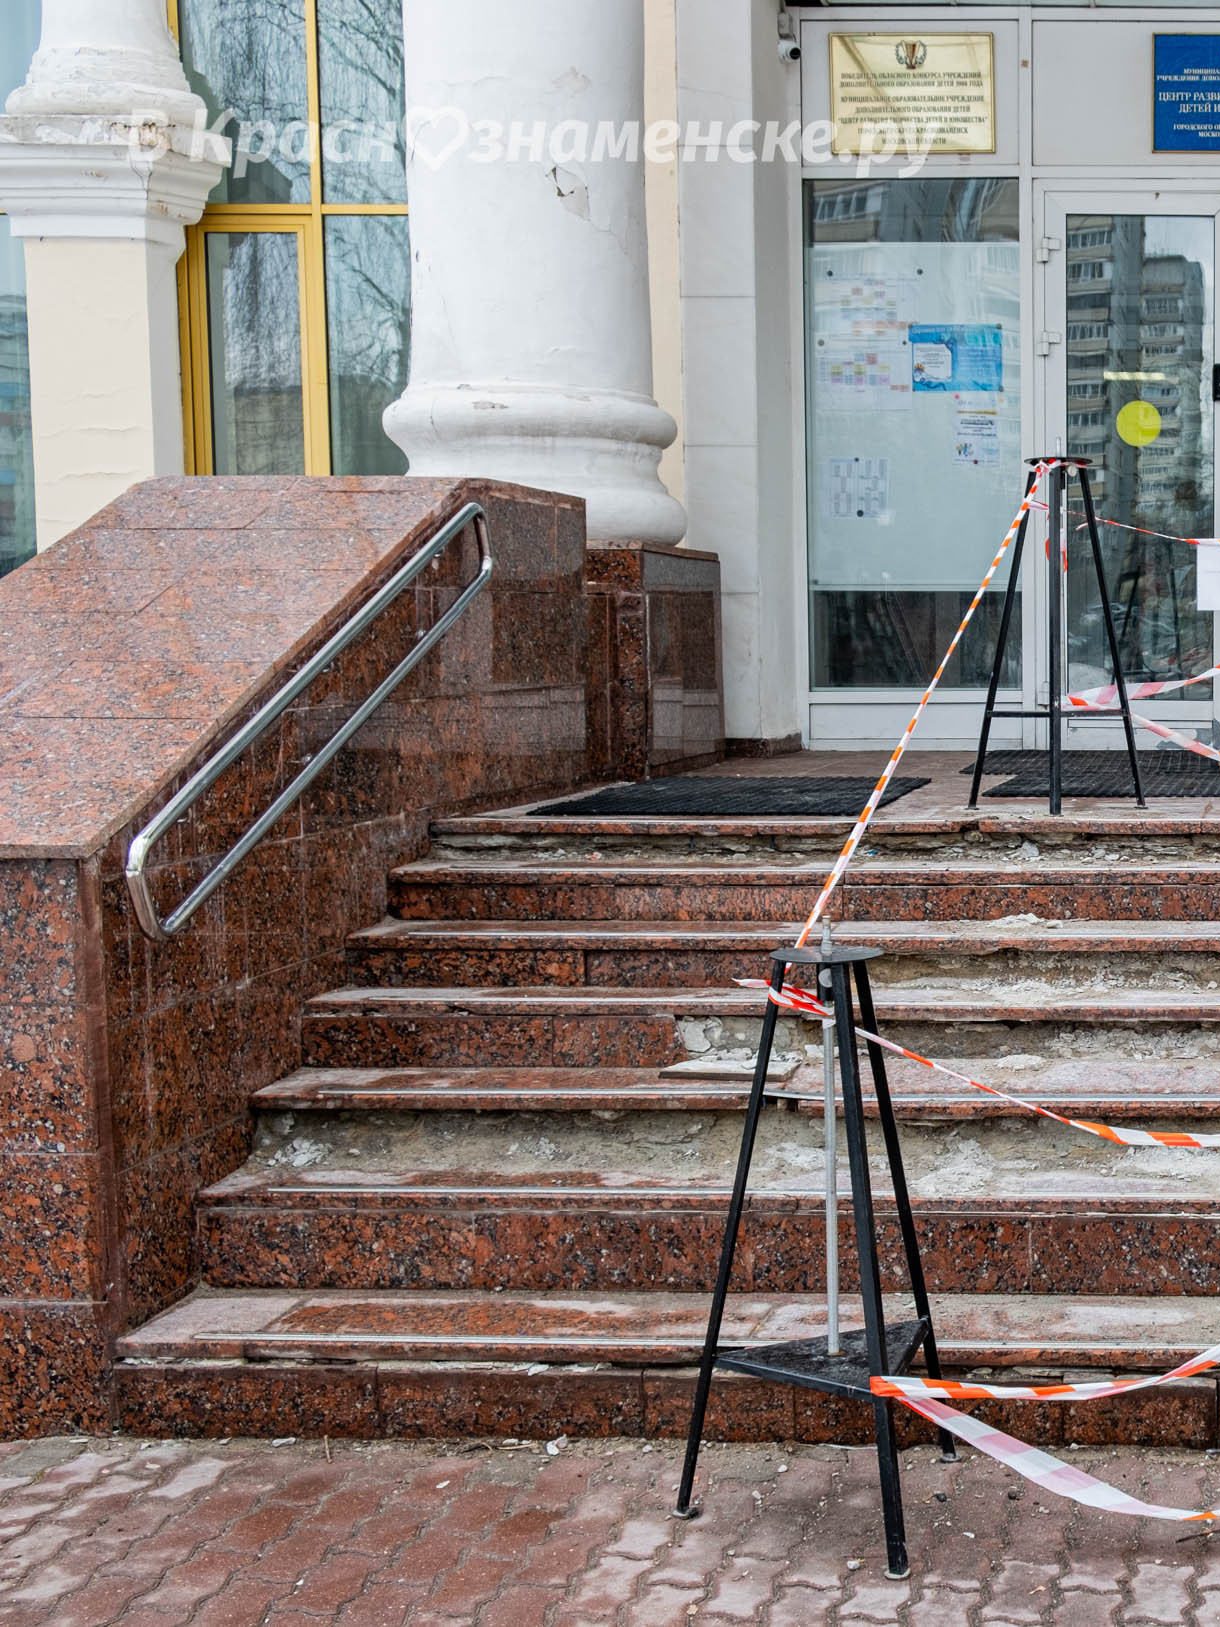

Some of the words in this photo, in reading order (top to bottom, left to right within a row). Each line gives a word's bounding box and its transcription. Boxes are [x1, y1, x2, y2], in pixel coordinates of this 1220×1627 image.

[942, 71, 982, 79] УЧРЕЖДЕНИЙ
[839, 80, 895, 88] ДОПОЛНИТЕЛЬНОГО
[969, 80, 983, 88] ГОДА
[1158, 92, 1191, 102] ЦЕНТР
[952, 105, 970, 113] ДЕТЕЙ
[1178, 102, 1211, 113] ДЕТЕЙ
[1213, 104, 1220, 112] И
